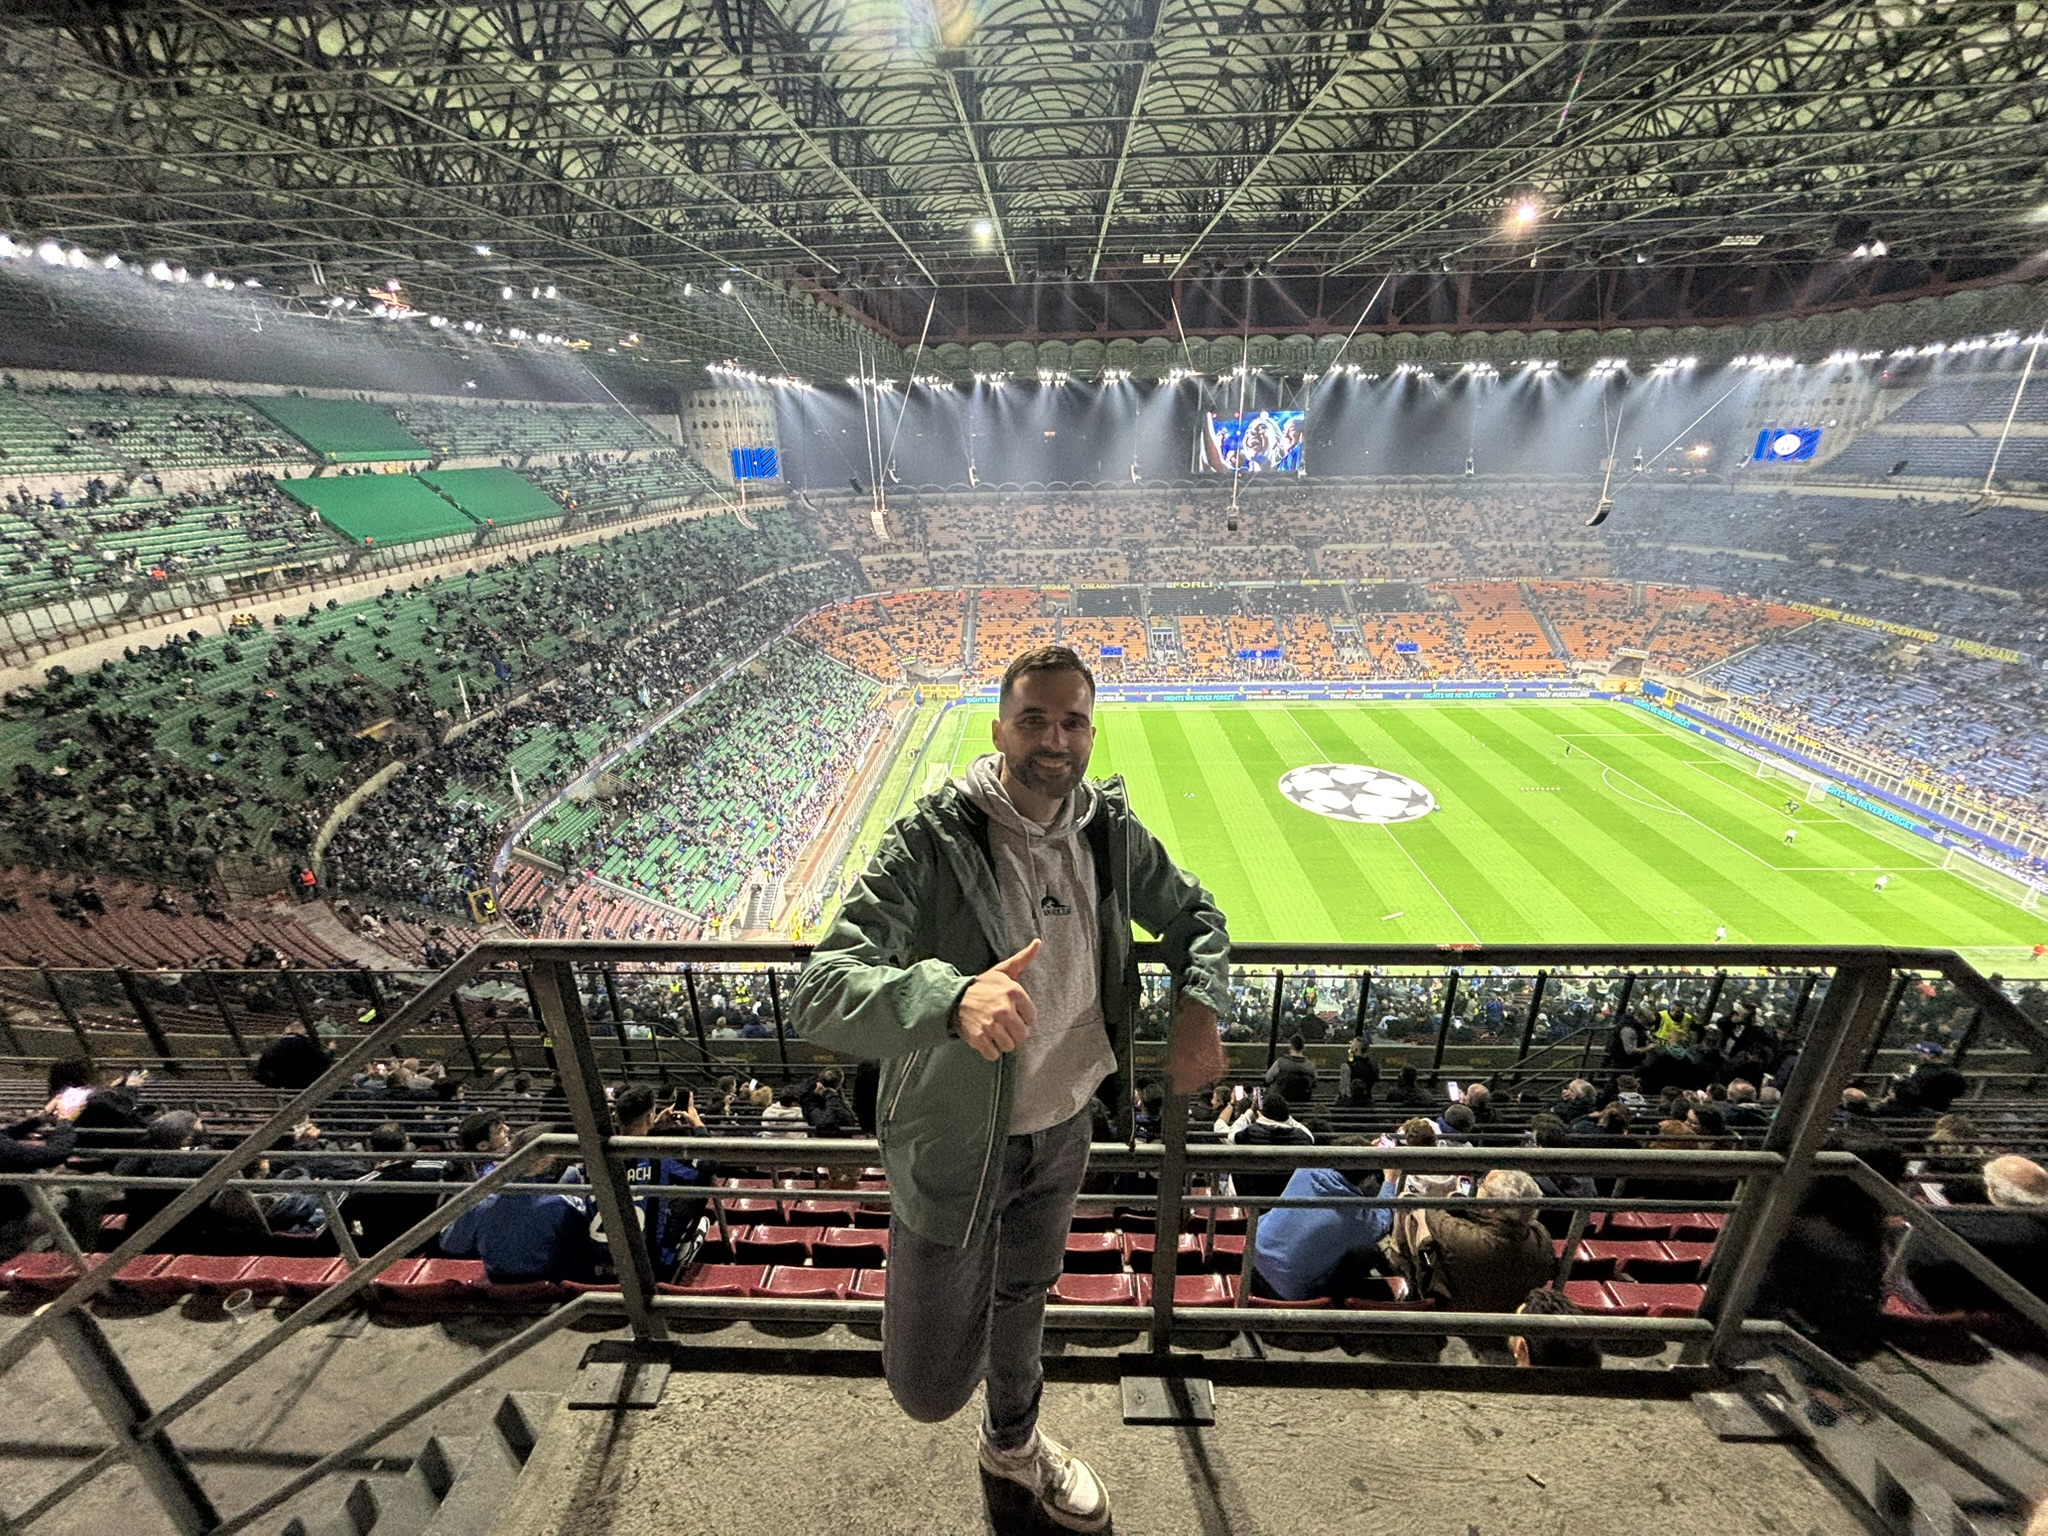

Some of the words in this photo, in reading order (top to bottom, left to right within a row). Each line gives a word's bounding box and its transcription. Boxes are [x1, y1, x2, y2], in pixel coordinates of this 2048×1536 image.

[1842, 614, 1874, 627] BASSO
[1882, 623, 1939, 642] VICENTINO
[1820, 782, 1846, 799] NIGHTS
[1858, 799, 1884, 817] NEVER
[1883, 810, 1916, 831] FORGET
